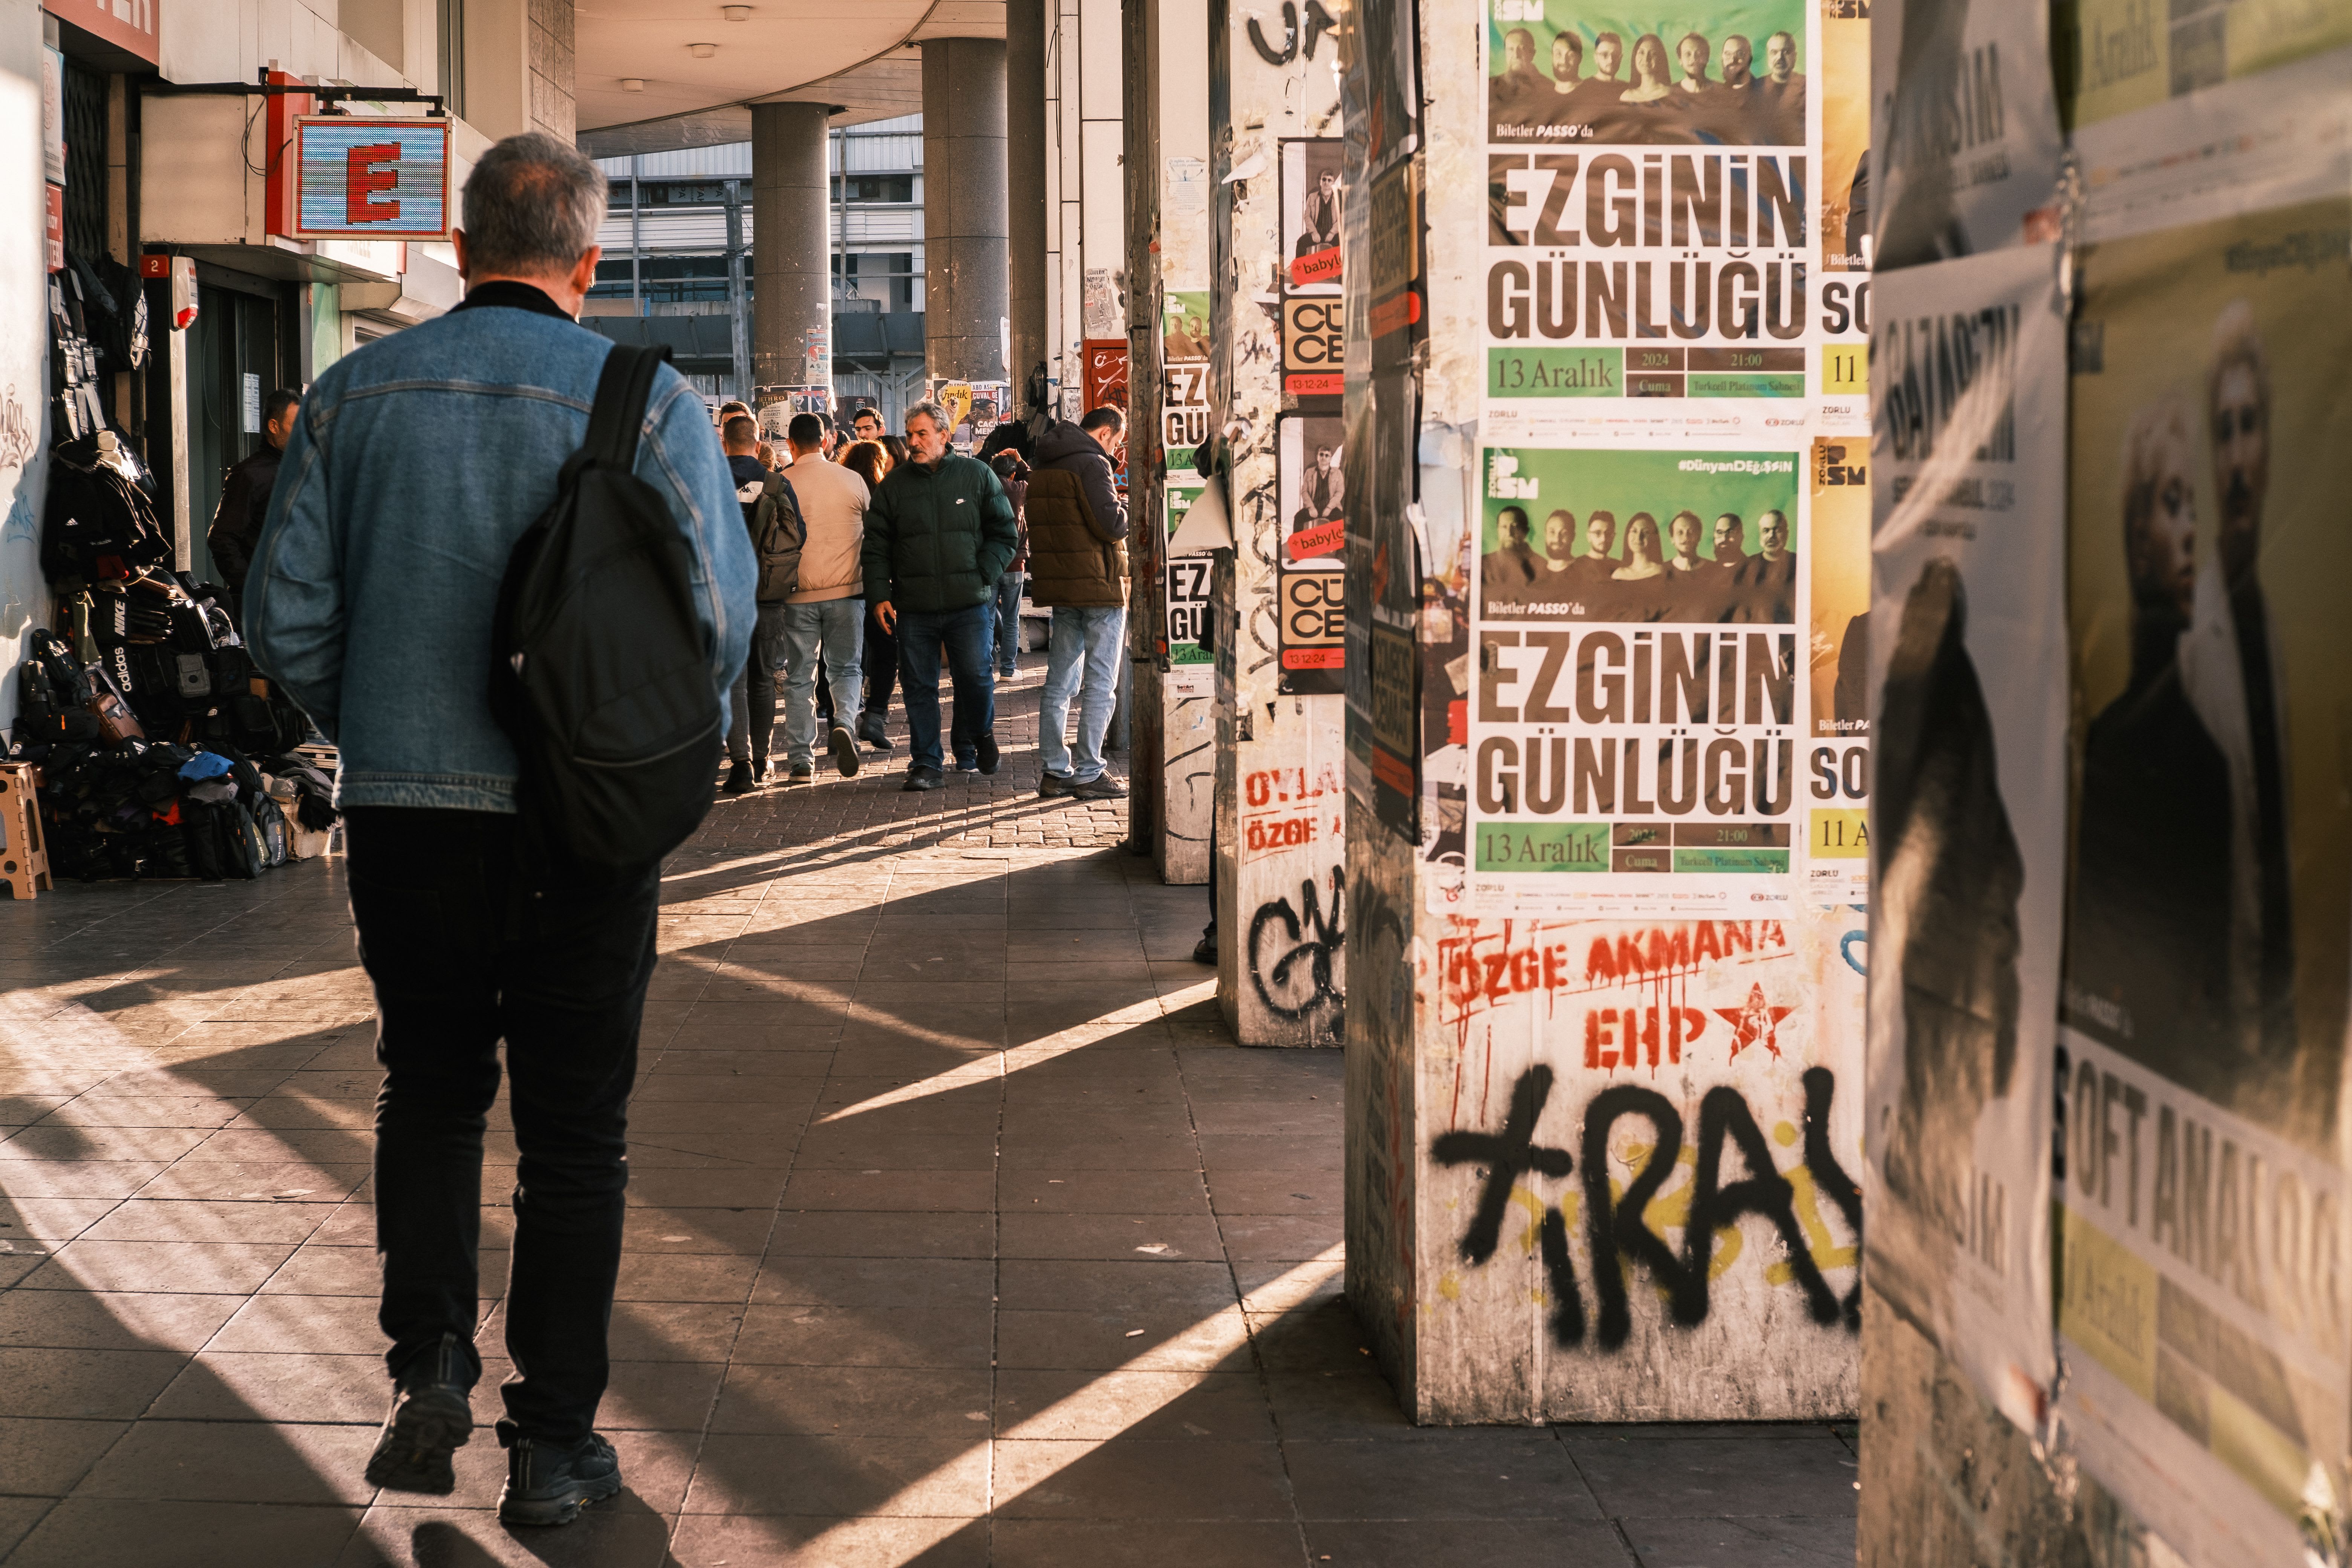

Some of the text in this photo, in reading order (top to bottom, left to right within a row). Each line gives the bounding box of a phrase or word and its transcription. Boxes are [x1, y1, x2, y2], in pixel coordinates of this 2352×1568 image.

[1496, 124, 1534, 138] Biletler
[346, 141, 401, 224] E
[151, 260, 158, 272] 2
[1488, 251, 1807, 340] GÜNLÜĞÜ
[1642, 353, 1669, 366] 2024
[1730, 354, 1762, 367] 21:00
[1497, 357, 1613, 390] 13 Aralık
[1638, 379, 1671, 392] Cuma
[1488, 602, 1525, 615] Biletler
[115, 599, 125, 637] NIKE
[115, 647, 132, 692] adidas
[1819, 720, 1854, 731] Biletler
[1476, 728, 1793, 816] GÜNLÜĞÜ
[1628, 828, 1655, 841] 2024
[1717, 829, 1748, 842] 21:00
[1822, 820, 1844, 846] 11
[1485, 832, 1600, 864] 13 Aralık
[1625, 855, 1657, 868] Cuma
[1584, 1006, 1707, 1069] EHP
